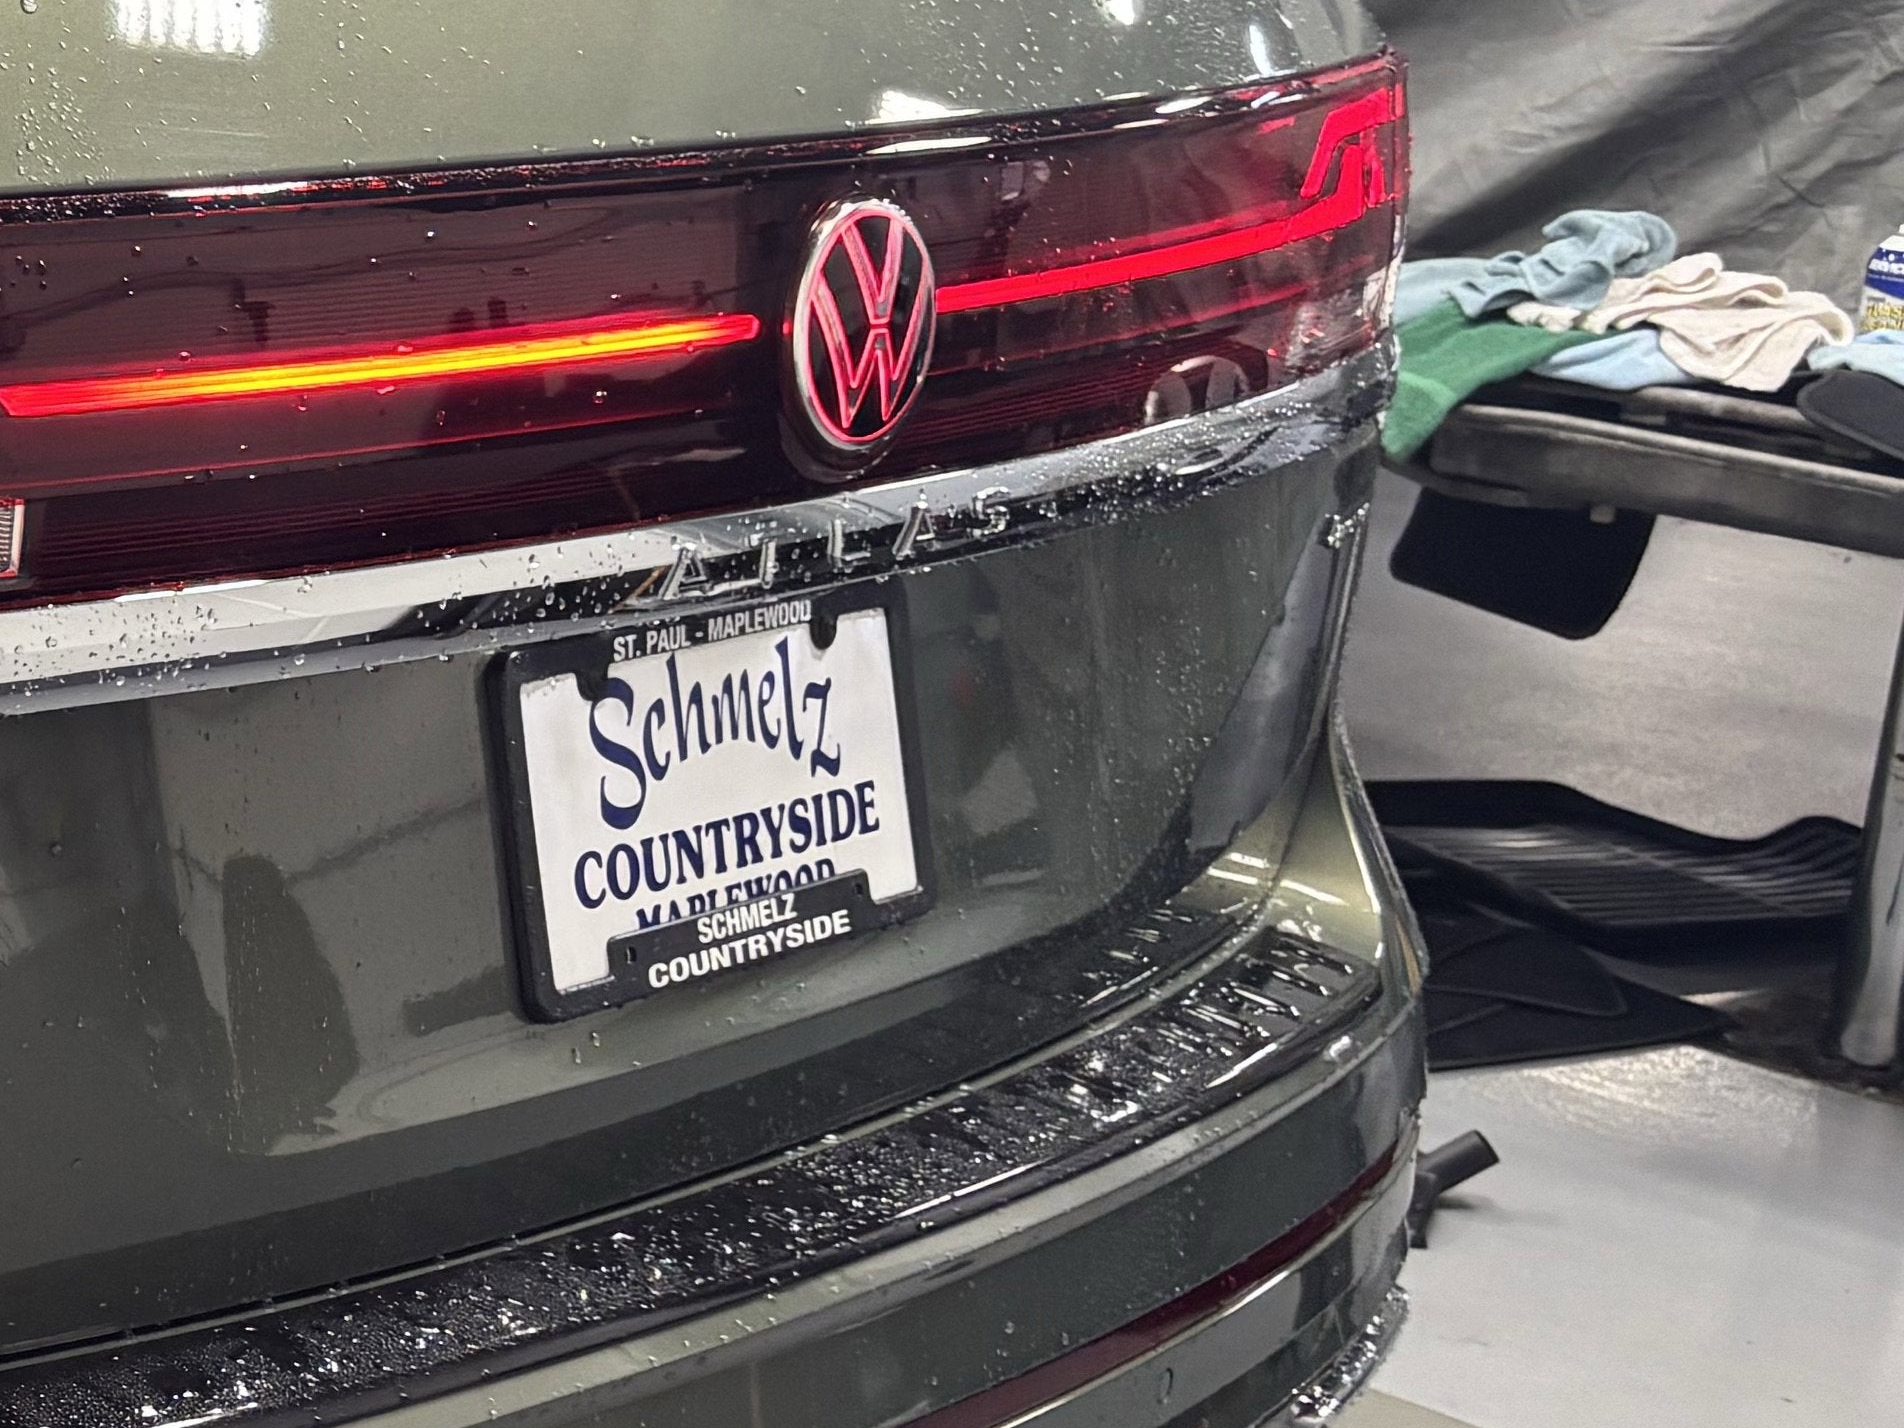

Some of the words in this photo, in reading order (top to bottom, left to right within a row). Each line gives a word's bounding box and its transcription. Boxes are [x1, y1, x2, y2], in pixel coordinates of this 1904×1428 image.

[804, 207, 930, 444] VW
[658, 487, 1011, 600] ATLAS
[613, 633, 642, 662] ST.
[646, 624, 691, 654] PAUL
[708, 599, 812, 641] MAPLEWOOD
[590, 635, 841, 829] Schmelz
[574, 780, 880, 909] COUNTRYSIDE
[648, 909, 853, 989] COUNTRYSIDE
[697, 893, 798, 944] SCHMELZ
